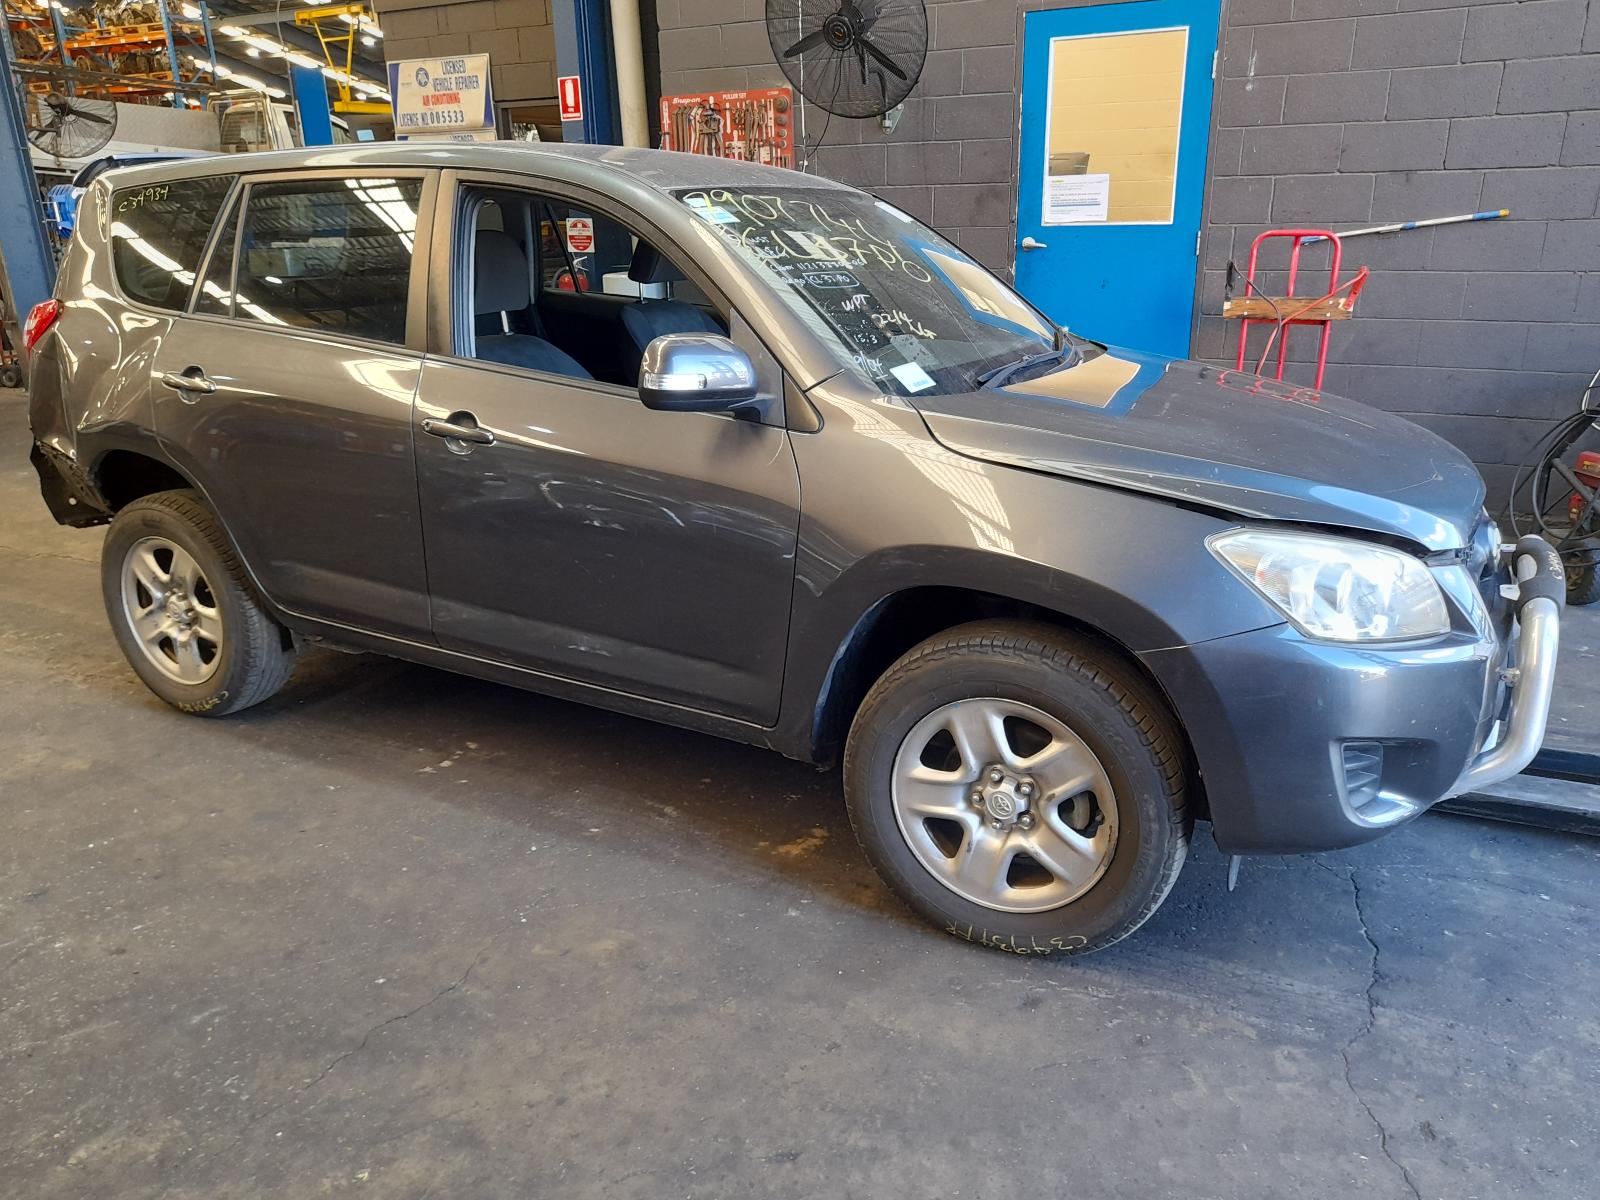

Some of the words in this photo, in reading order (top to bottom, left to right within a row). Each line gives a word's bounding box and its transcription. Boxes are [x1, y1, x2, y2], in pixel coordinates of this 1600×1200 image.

[441, 59, 467, 75] LICENSED
[432, 76, 453, 92] VEHICLE
[455, 75, 480, 90] REPAIRER
[430, 110, 465, 125] 005533
